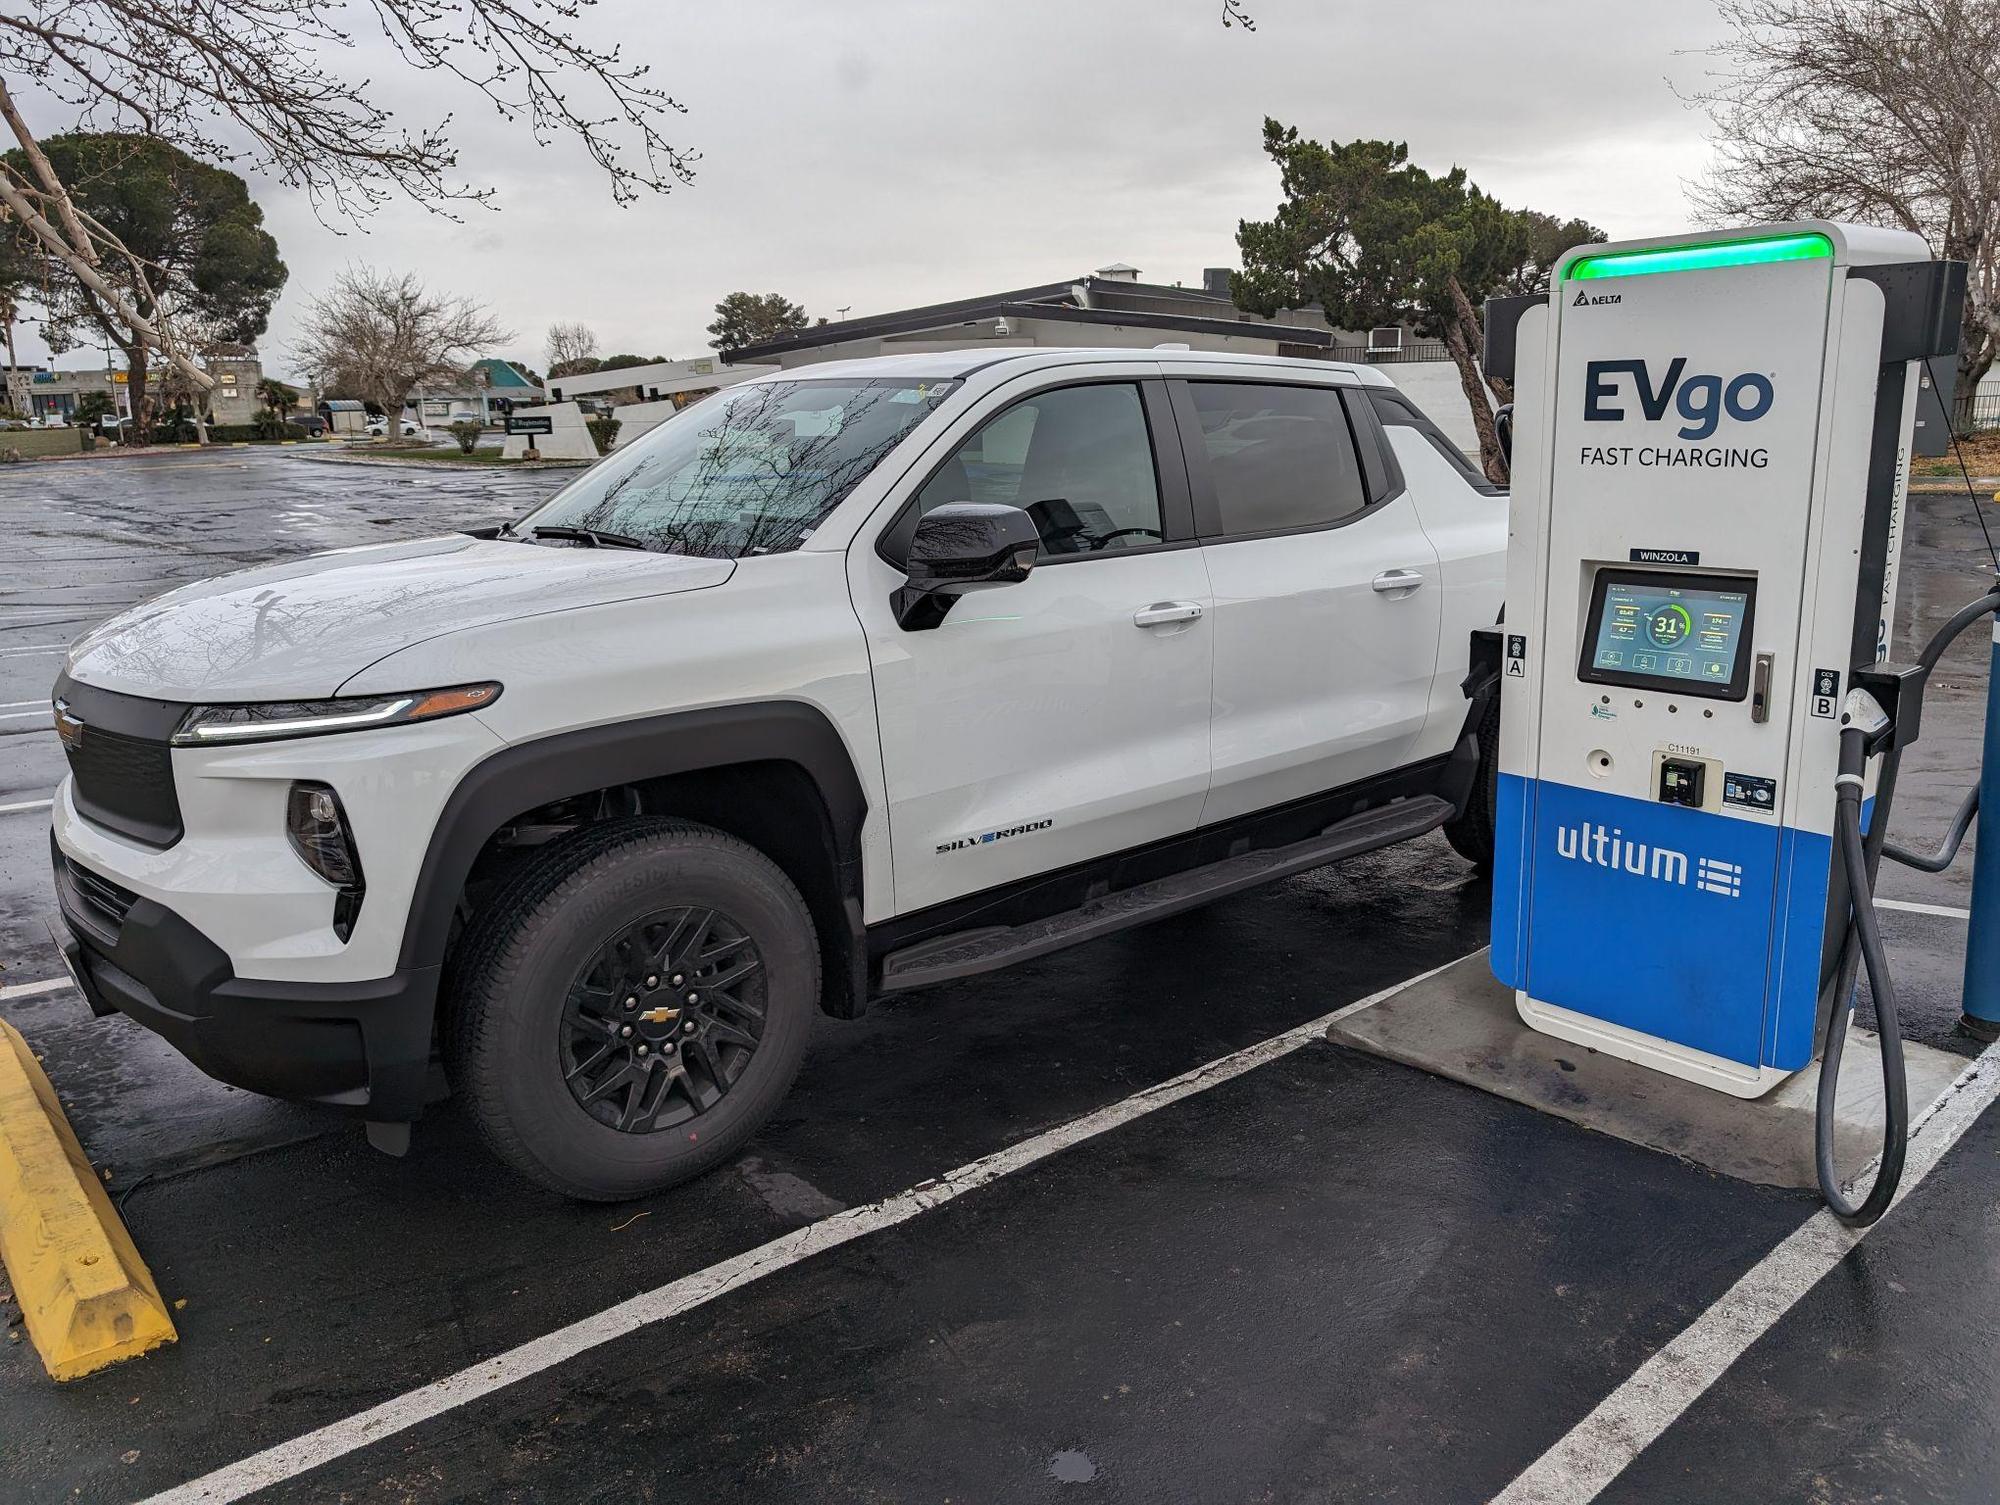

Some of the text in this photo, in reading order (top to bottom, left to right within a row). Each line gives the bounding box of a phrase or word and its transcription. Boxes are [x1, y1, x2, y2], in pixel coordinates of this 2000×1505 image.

[1592, 295, 1621, 305] DELTA
[1584, 358, 1774, 440] EVgo
[1580, 448, 1769, 468] FAST CHARGING
[1640, 551, 1688, 562] WINZOLA
[1654, 616, 1677, 634] 31
[1510, 660, 1521, 674] A
[1817, 698, 1830, 714] B
[1668, 743, 1701, 755] C11191
[936, 818, 1053, 855] SILVERADO
[1557, 822, 1688, 886] ultium
